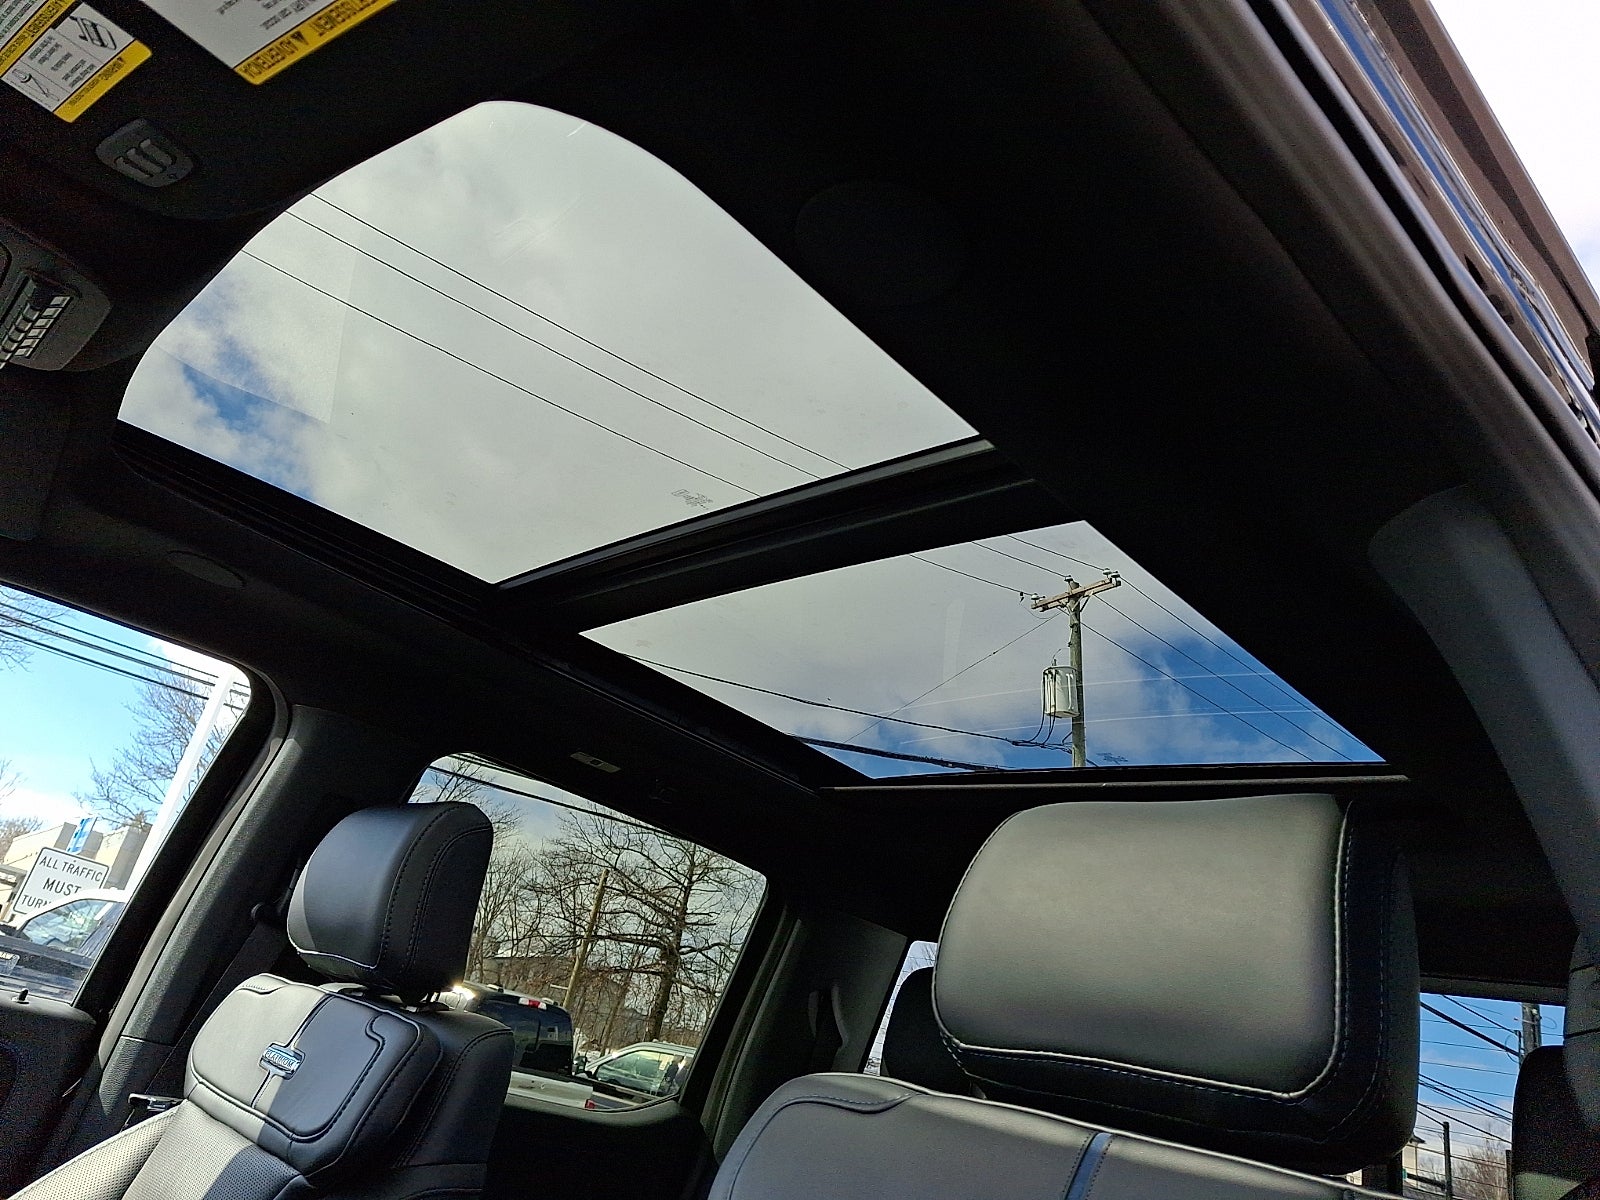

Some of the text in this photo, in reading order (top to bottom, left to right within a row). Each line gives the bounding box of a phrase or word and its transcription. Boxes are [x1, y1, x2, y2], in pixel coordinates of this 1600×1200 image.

[39, 856, 103, 882] ALL TRAFFIC
[43, 877, 82, 896] MUST
